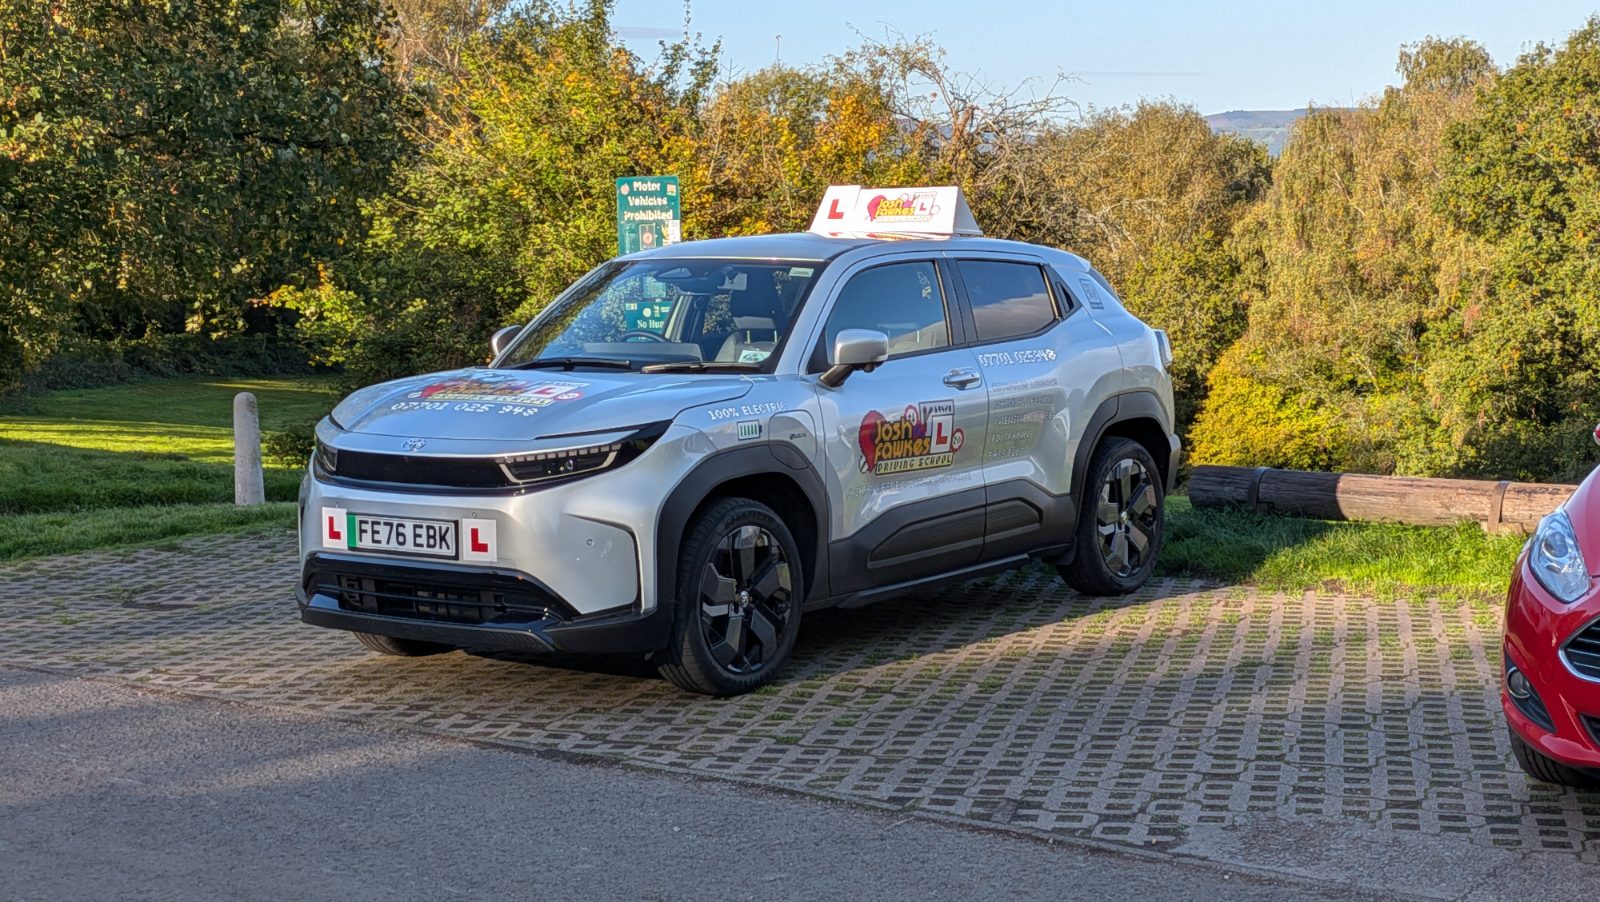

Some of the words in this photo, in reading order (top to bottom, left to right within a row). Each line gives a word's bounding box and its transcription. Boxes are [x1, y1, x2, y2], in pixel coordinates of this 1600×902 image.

[633, 181, 661, 191] Motor
[628, 195, 668, 206] Vehicles
[828, 199, 844, 219] L
[919, 202, 927, 211] L
[624, 209, 673, 220] Prohibited
[637, 320, 647, 328] No
[391, 402, 449, 411] 07701
[454, 402, 495, 412] 025
[498, 405, 538, 416] 948
[708, 408, 739, 420] 100%
[741, 401, 786, 416] ELECTRIC
[875, 416, 912, 440] Josh
[936, 422, 948, 445] L
[877, 460, 914, 473] DRIVING
[918, 456, 951, 467] SCHOOL
[328, 516, 341, 540] L
[359, 519, 406, 546] FE76
[413, 524, 450, 550] EBK
[471, 528, 488, 552] L
